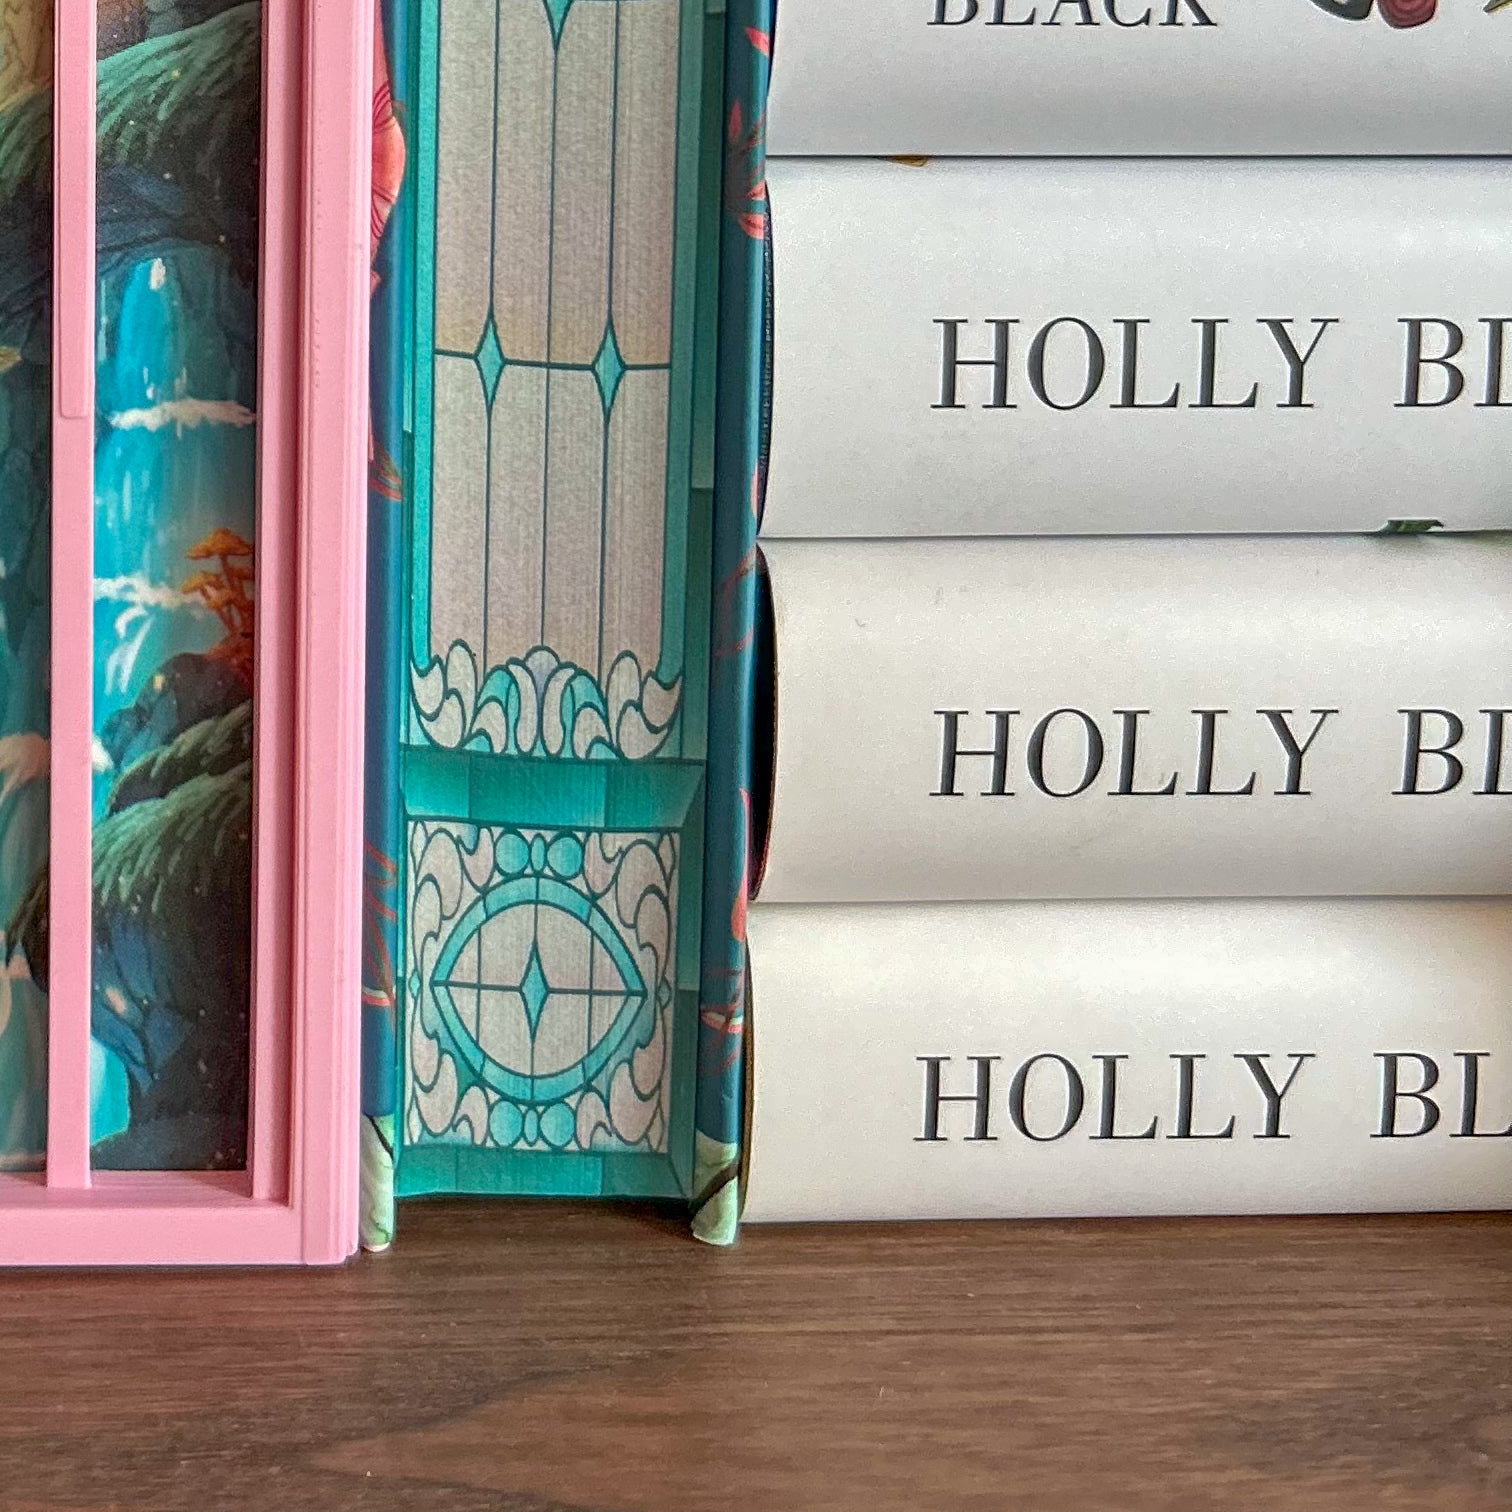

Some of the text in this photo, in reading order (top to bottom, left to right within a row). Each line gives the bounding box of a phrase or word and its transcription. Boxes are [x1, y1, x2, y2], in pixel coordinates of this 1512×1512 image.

[930, 317, 1340, 411] HOLLY
[929, 708, 1340, 798] HOLLY
[913, 1053, 1317, 1143] HOLLY
